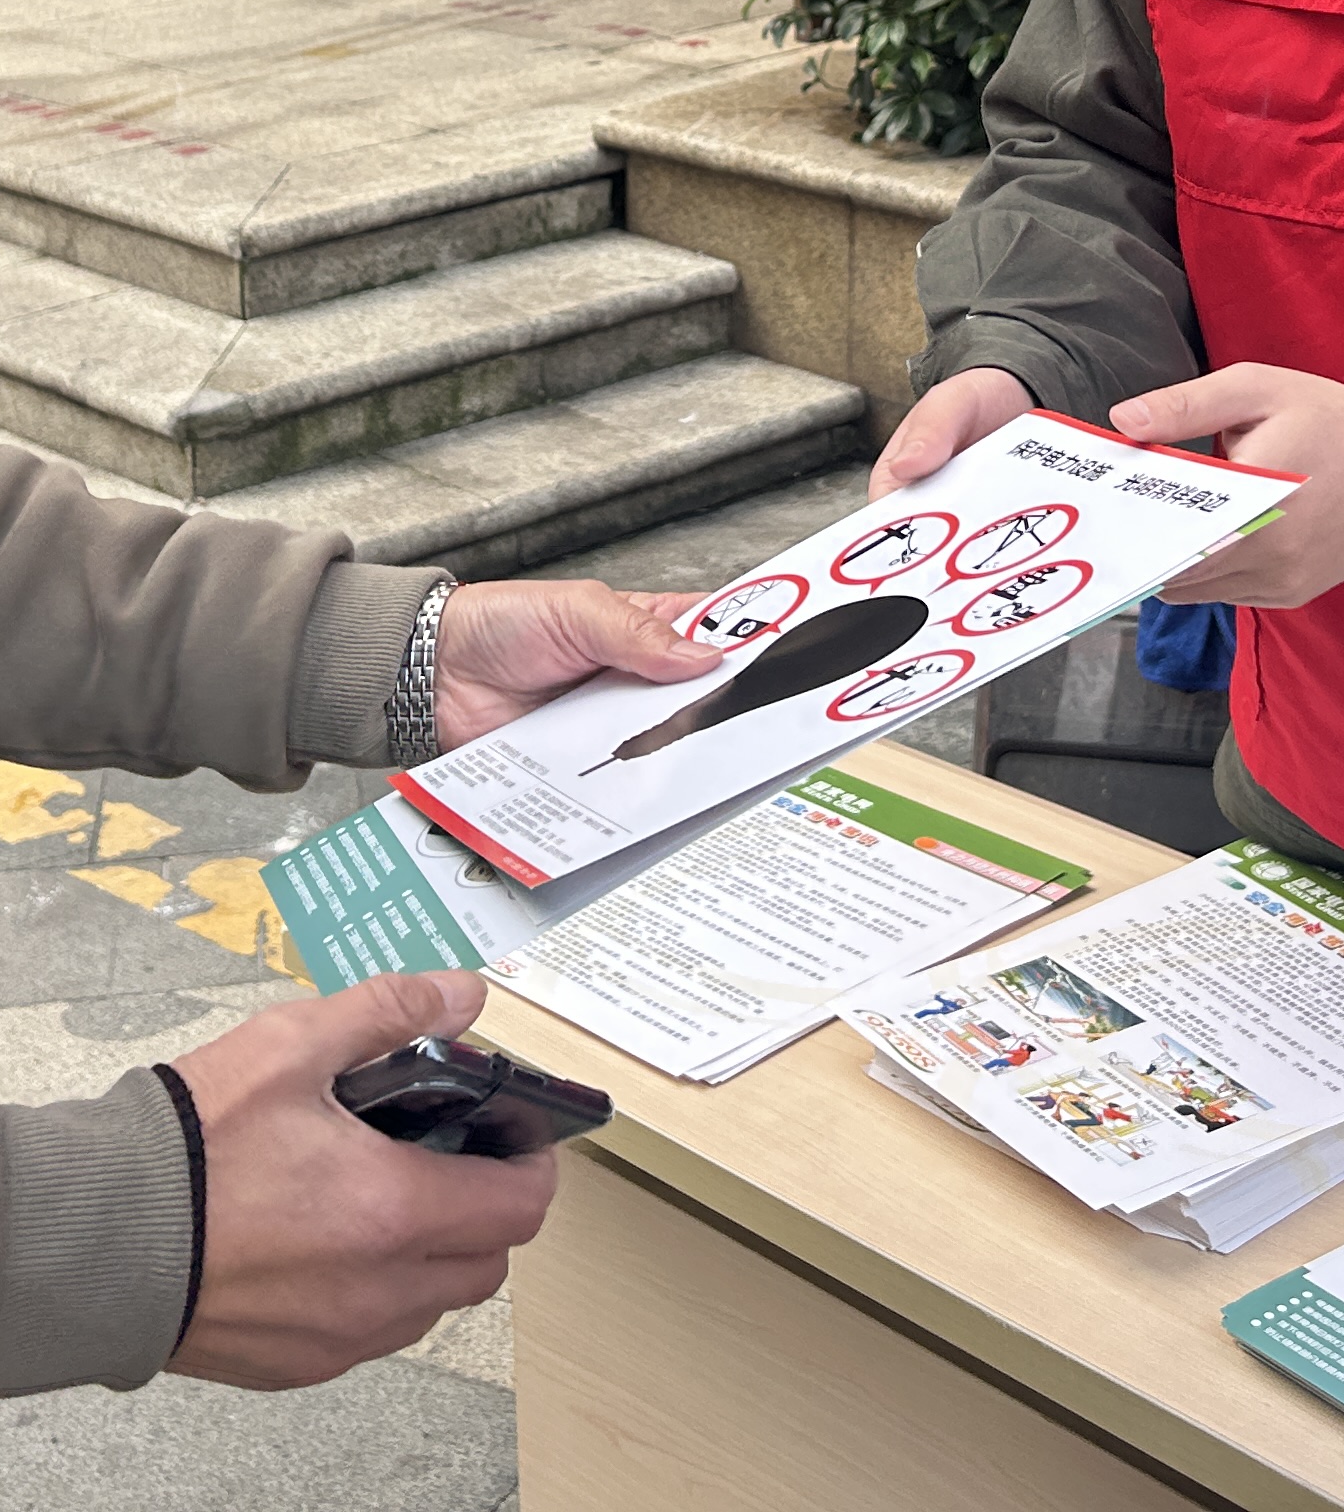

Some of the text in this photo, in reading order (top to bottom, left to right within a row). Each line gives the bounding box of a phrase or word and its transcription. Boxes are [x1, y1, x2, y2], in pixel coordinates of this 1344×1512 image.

[1006, 438, 1232, 513] 保护电力设施 光明常伴身边
